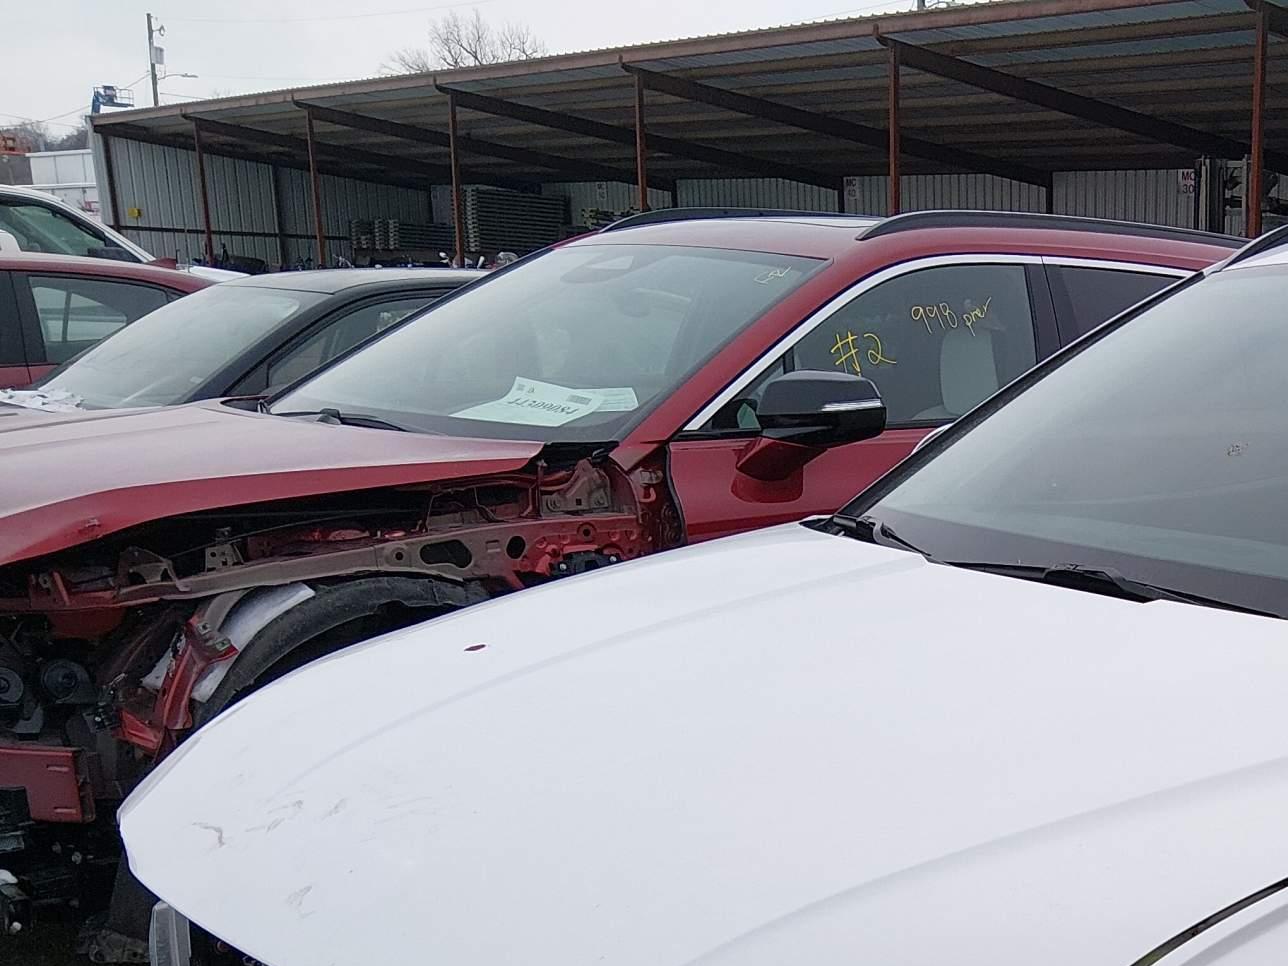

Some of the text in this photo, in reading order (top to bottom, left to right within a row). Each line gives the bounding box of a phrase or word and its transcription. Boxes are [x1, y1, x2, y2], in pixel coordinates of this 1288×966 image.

[1182, 184, 1195, 194] 30
[911, 302, 958, 335] 998
[830, 331, 897, 378] #2
